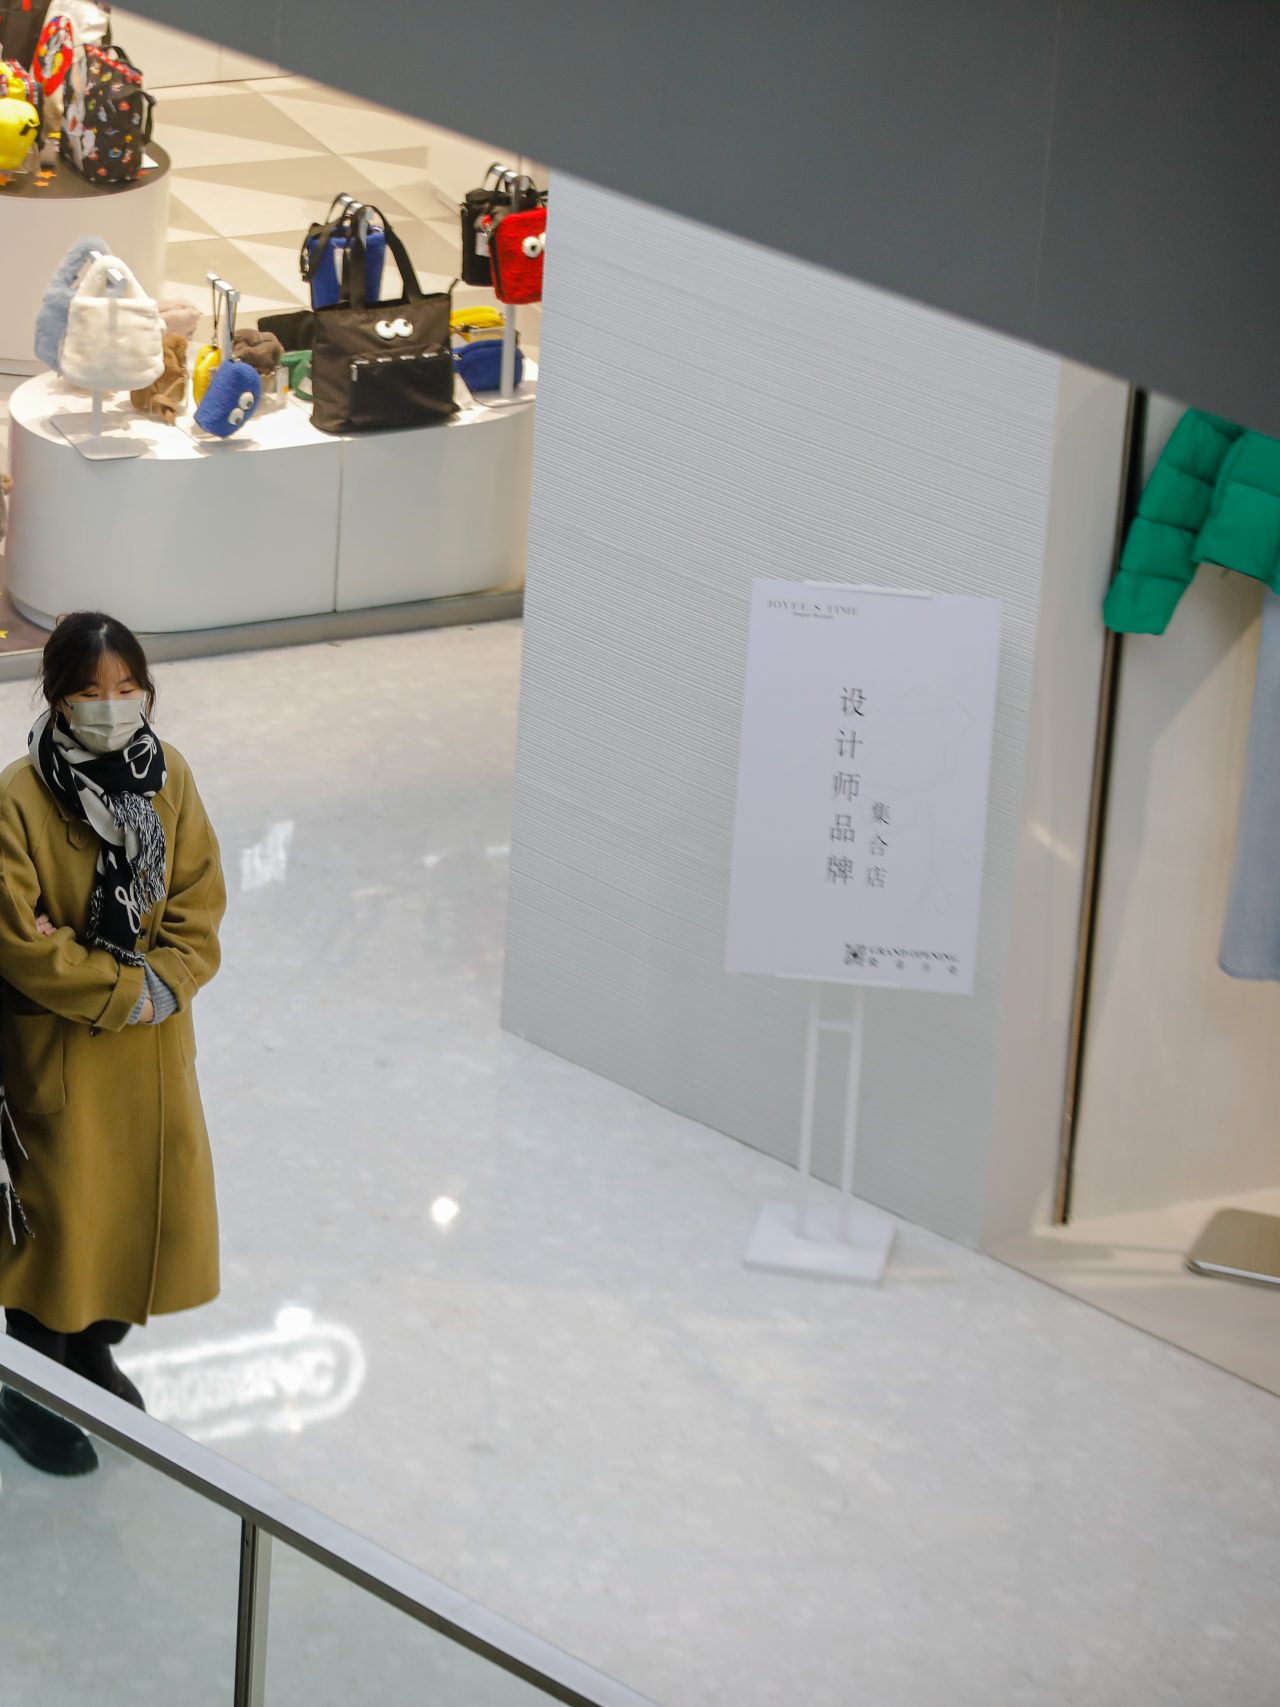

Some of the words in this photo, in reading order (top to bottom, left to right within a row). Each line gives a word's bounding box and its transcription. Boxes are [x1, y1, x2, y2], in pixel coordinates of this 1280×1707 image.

[826, 686, 868, 887] 设计师品牌
[867, 801, 892, 890] 集合店
